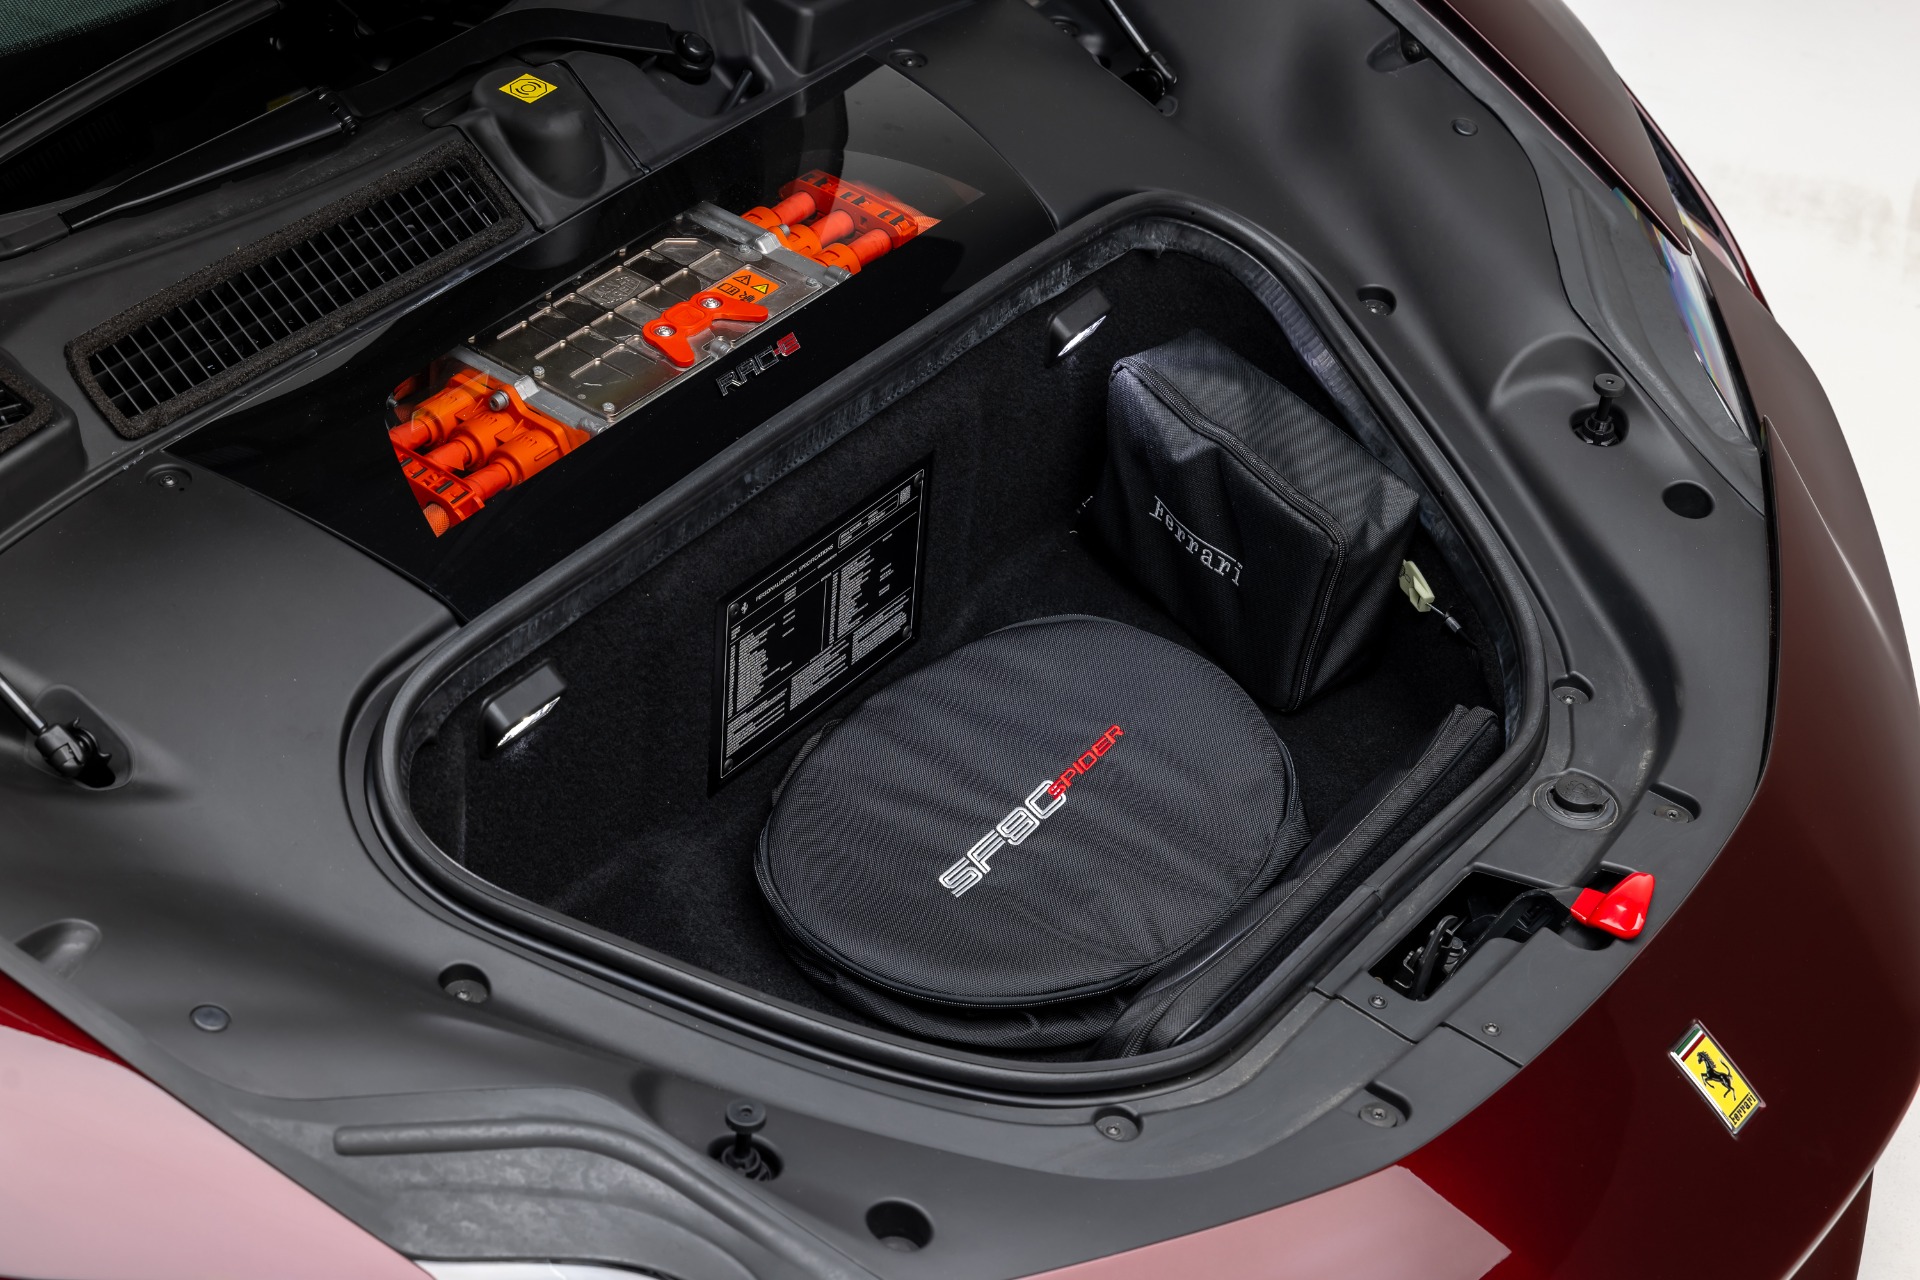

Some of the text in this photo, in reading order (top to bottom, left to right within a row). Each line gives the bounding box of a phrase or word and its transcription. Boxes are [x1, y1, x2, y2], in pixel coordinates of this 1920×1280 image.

[1149, 495, 1243, 586] Ferrari
[939, 724, 1124, 898] SF90 SPIDER
[1728, 1092, 1757, 1125] Ferrari
